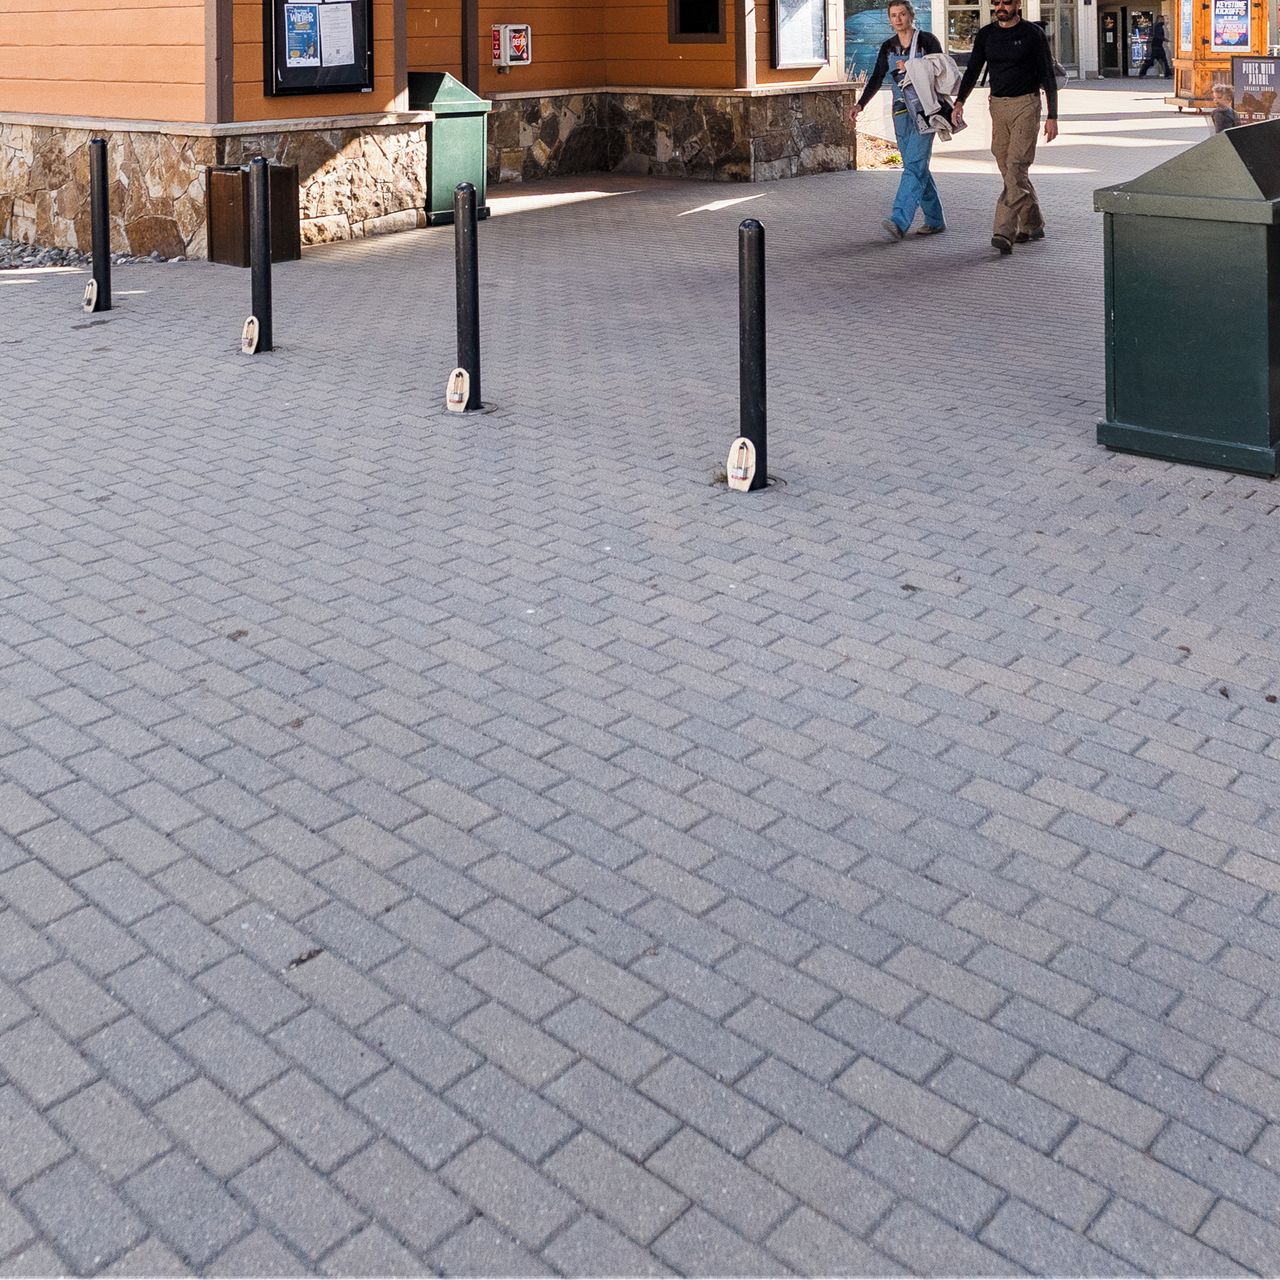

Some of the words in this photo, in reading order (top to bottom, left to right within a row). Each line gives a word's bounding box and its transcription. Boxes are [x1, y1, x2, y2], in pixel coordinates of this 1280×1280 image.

[1216, 0, 1247, 8] KEYSTONE
[1242, 62, 1259, 74] PINTS
[1260, 63, 1275, 75] WITH
[1248, 73, 1269, 85] PATROL
